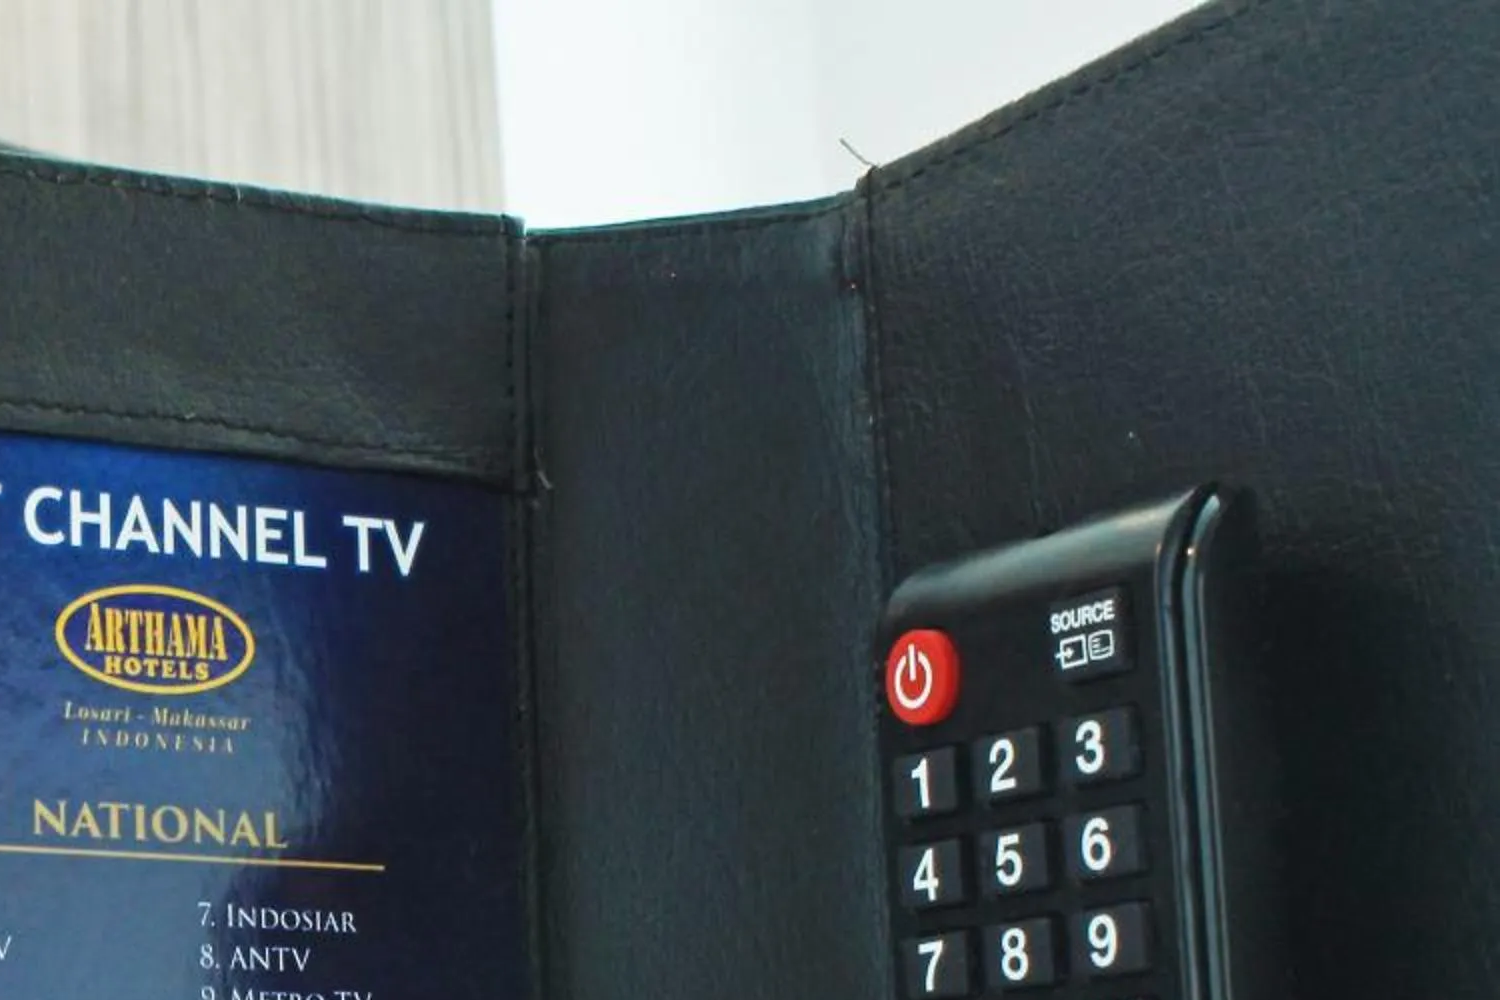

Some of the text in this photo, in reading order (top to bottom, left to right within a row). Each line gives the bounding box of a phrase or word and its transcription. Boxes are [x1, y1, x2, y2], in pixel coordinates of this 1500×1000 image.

[23, 486, 326, 569] CHANNEL
[342, 514, 425, 576] TV
[84, 602, 228, 661] ARTHAMA
[1050, 599, 1116, 633] SOURCE
[104, 655, 210, 680] HOTELS
[63, 701, 131, 724] Losari
[151, 707, 251, 730] Makassar
[81, 728, 234, 753] INDONESIA
[989, 738, 1017, 792] 2
[1075, 720, 1104, 773] 3
[910, 758, 930, 809] 1
[33, 798, 289, 849] NATIONAL
[1081, 817, 1111, 870] 6
[913, 848, 938, 901] 4
[996, 834, 1022, 886] 5
[197, 901, 357, 934] 7. INDOSIAR
[1088, 914, 1117, 967] 9
[199, 943, 311, 973] 8. ANTV
[918, 940, 943, 992] 7
[1001, 927, 1029, 980] 8
